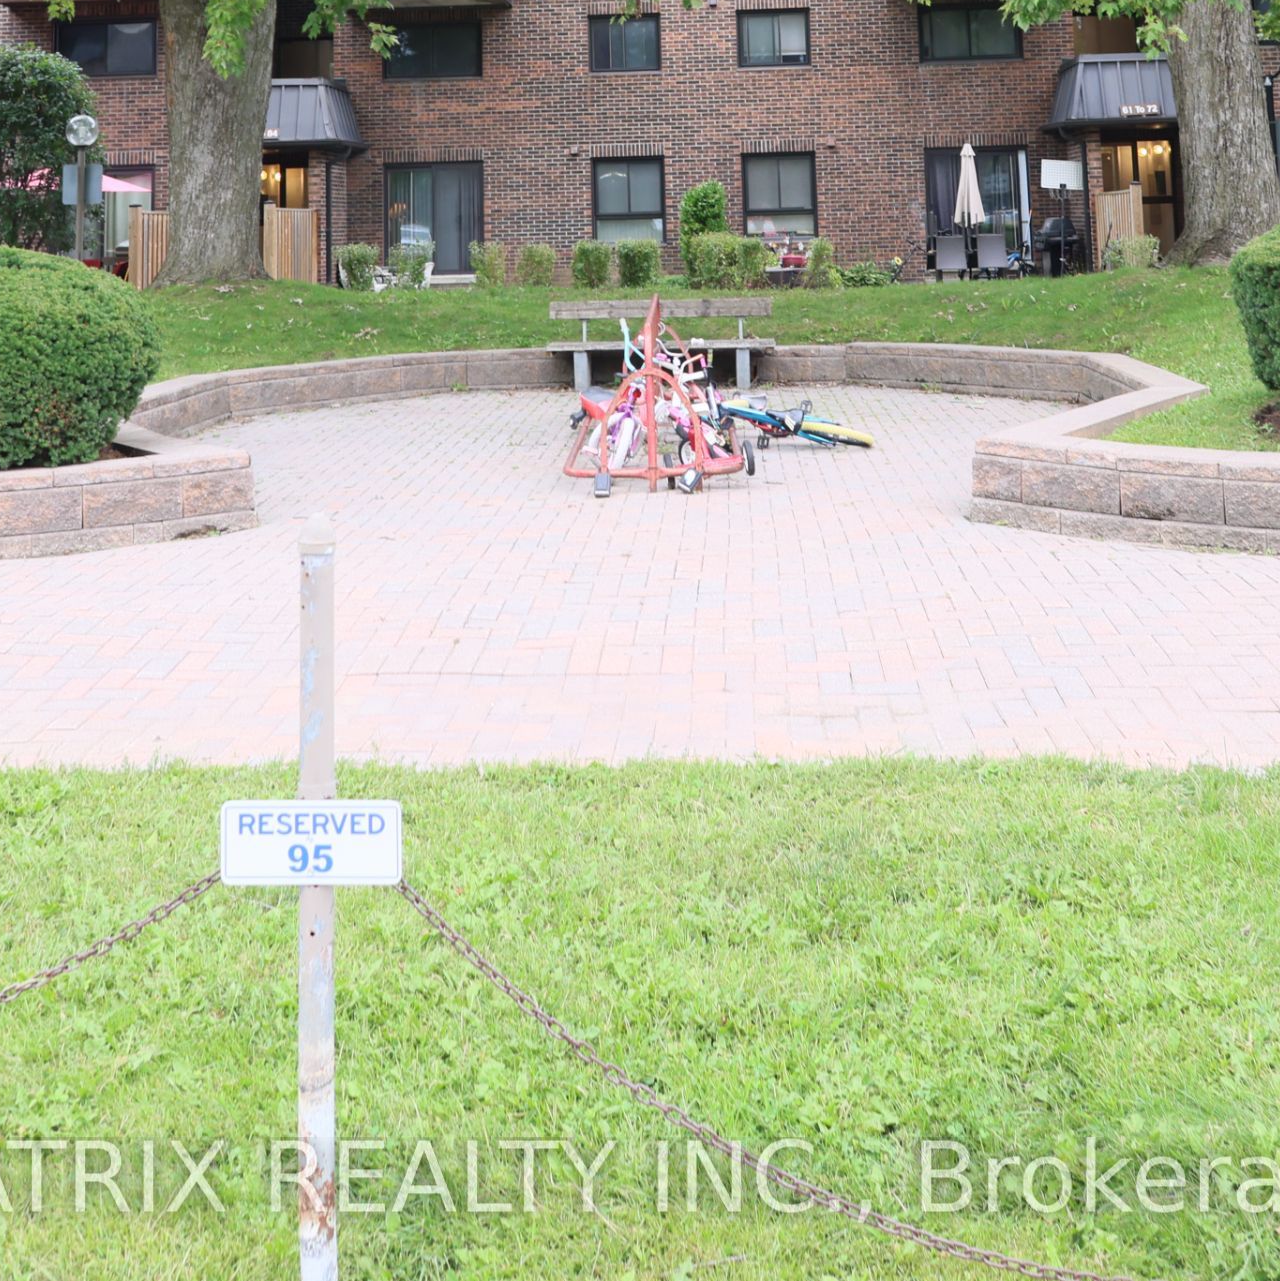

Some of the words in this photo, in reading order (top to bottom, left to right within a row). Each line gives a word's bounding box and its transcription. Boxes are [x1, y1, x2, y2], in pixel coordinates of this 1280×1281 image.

[1135, 104, 1145, 114] To
[1146, 103, 1159, 113] 72
[238, 813, 385, 835] RESERVED
[287, 844, 333, 872] 95
